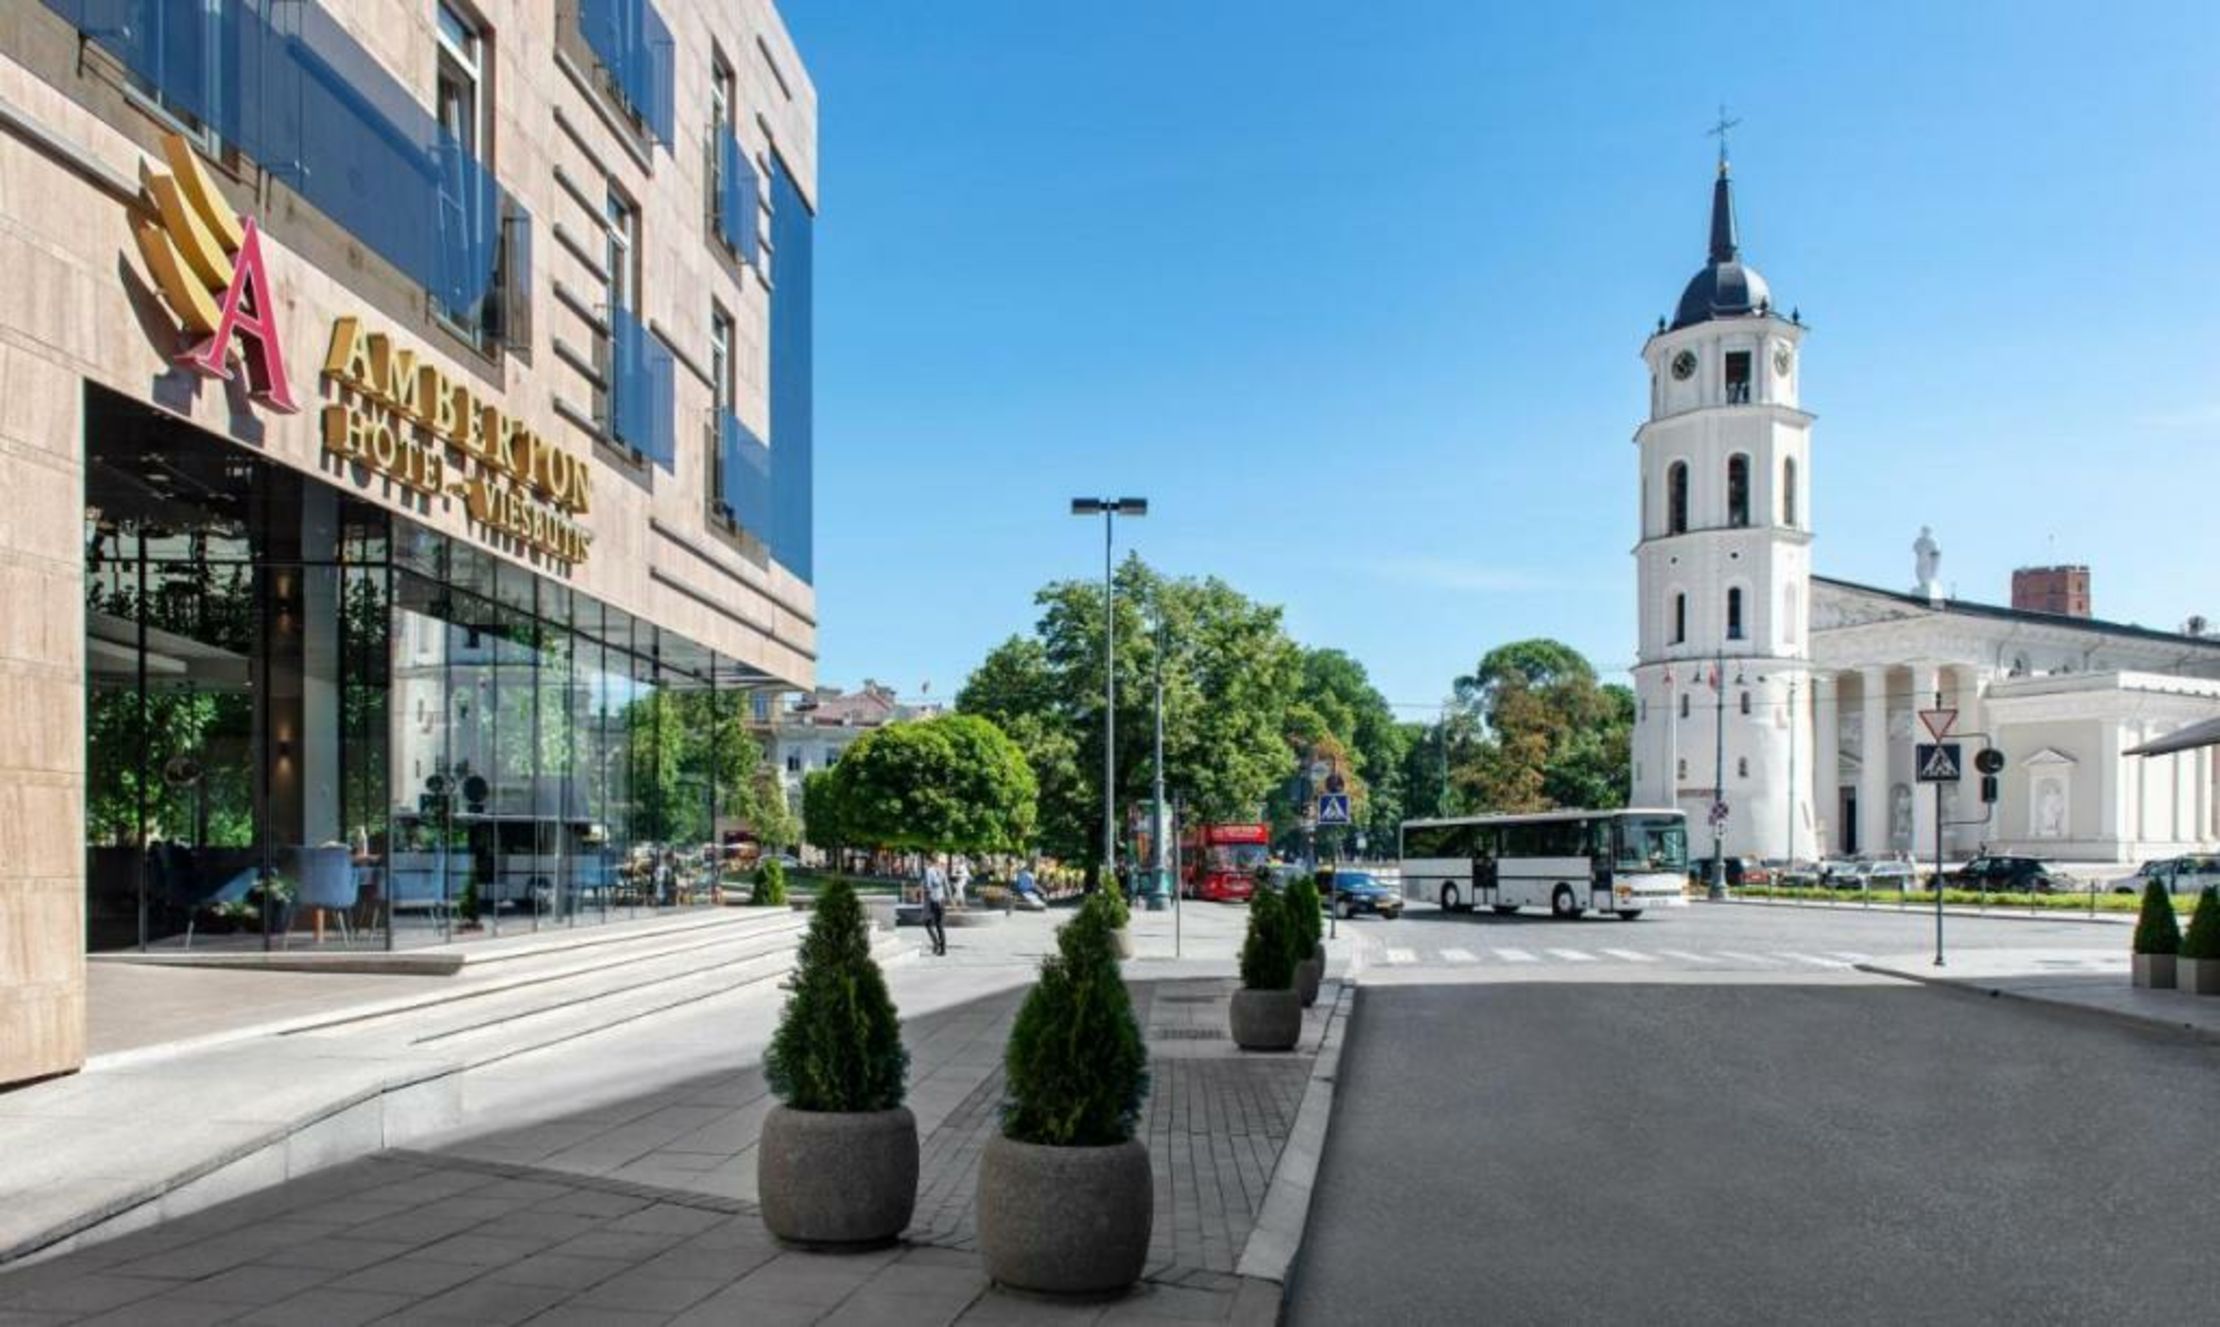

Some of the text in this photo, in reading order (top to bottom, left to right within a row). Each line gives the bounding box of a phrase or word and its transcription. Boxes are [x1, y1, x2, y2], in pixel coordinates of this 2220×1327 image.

[174, 215, 301, 415] A
[325, 316, 592, 513] AMBERTON
[325, 405, 452, 498] HOTEL
